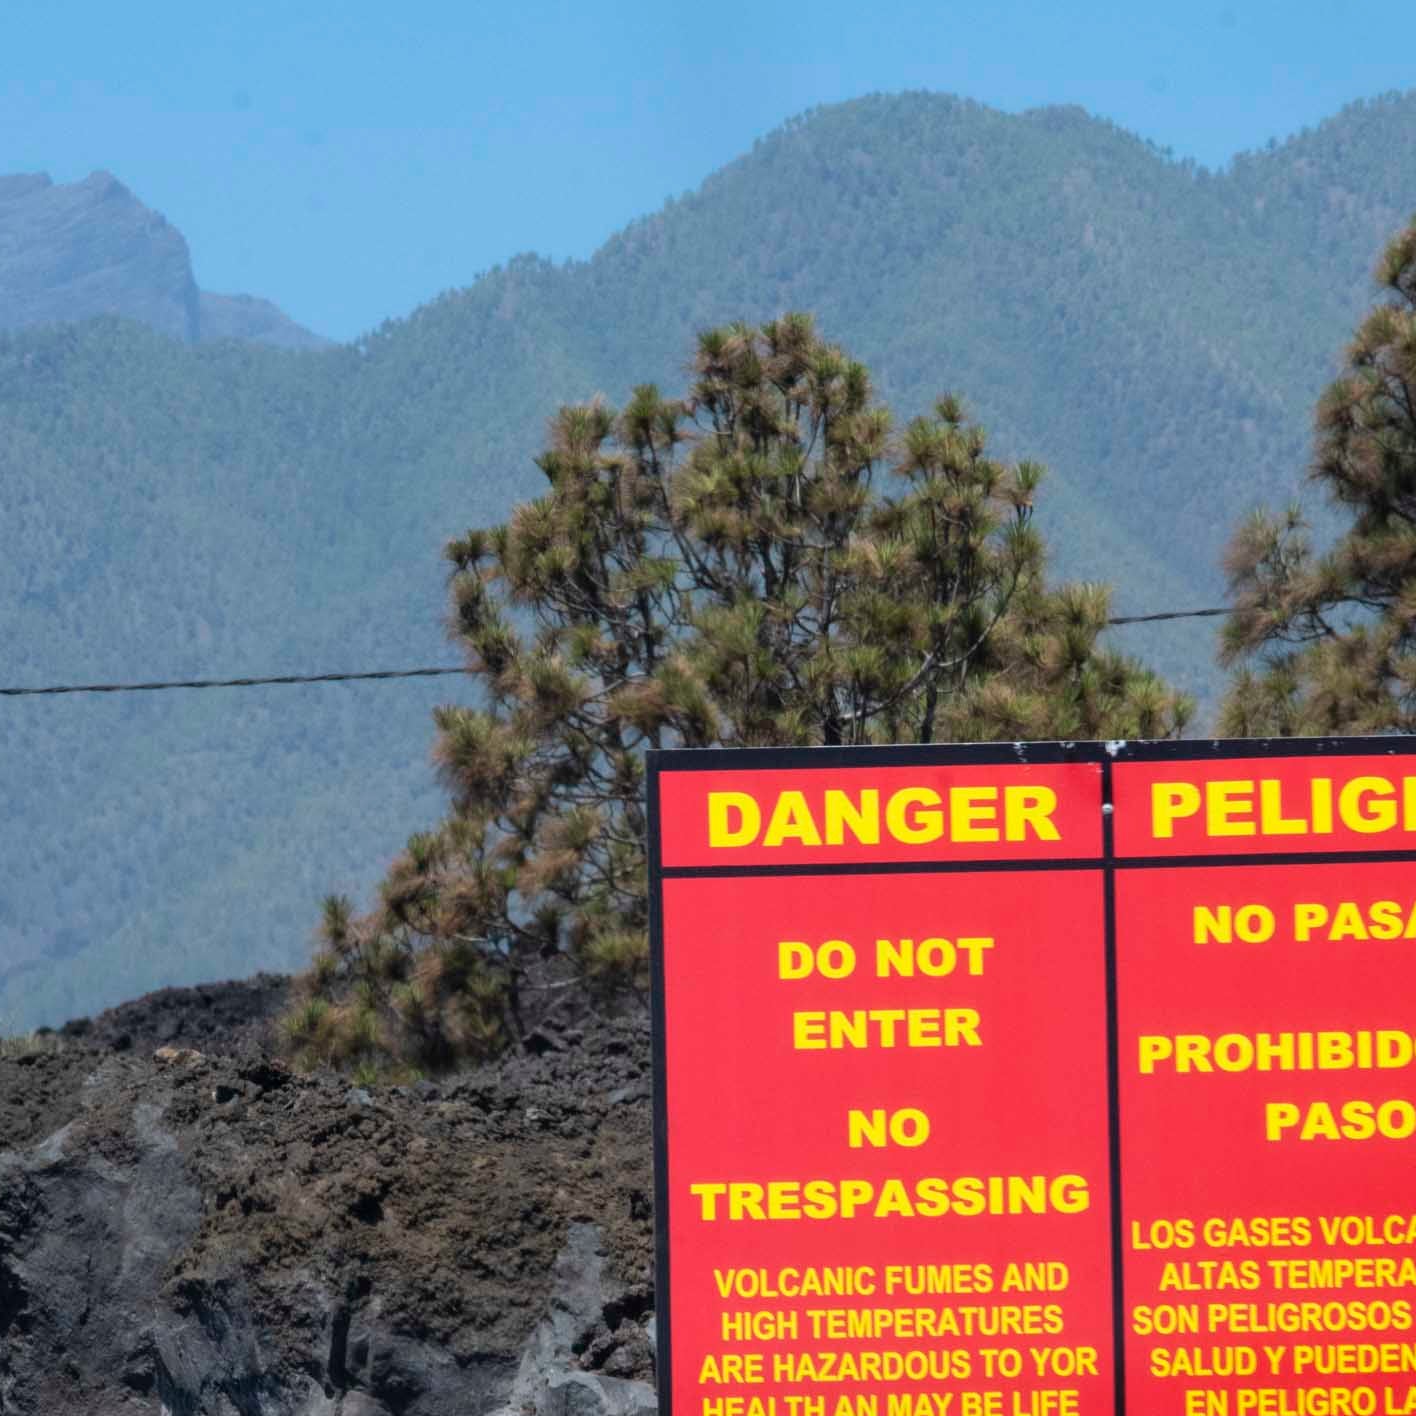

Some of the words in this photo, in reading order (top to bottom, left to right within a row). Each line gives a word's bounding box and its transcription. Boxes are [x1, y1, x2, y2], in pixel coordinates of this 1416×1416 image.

[707, 785, 1061, 848] DANGER
[1193, 904, 1276, 945] NO
[778, 939, 857, 980] DO
[875, 937, 995, 978] NOT
[793, 1007, 983, 1050] ENTER
[848, 1107, 930, 1148] NO
[690, 1174, 1090, 1221] TRESPASSING
[1131, 1218, 1196, 1250] LOS
[1203, 1216, 1312, 1248] GASES
[713, 1265, 876, 1299] VOLCANIC
[885, 1263, 994, 1295] FUMES
[1001, 1261, 1069, 1293] AND
[1159, 1260, 1261, 1292] ALTAS
[721, 1310, 798, 1341] HIGH
[805, 1304, 1064, 1339] TEMPERATURES
[1132, 1304, 1199, 1336] SON
[1207, 1299, 1413, 1333] PELIGROSOS
[698, 1353, 765, 1385] ARE
[773, 1349, 972, 1383] HAZARDOUS
[978, 1347, 1023, 1378] TO
[1029, 1346, 1099, 1377] YOR
[1150, 1346, 1257, 1378] SALUD
[1263, 1345, 1286, 1375] Y
